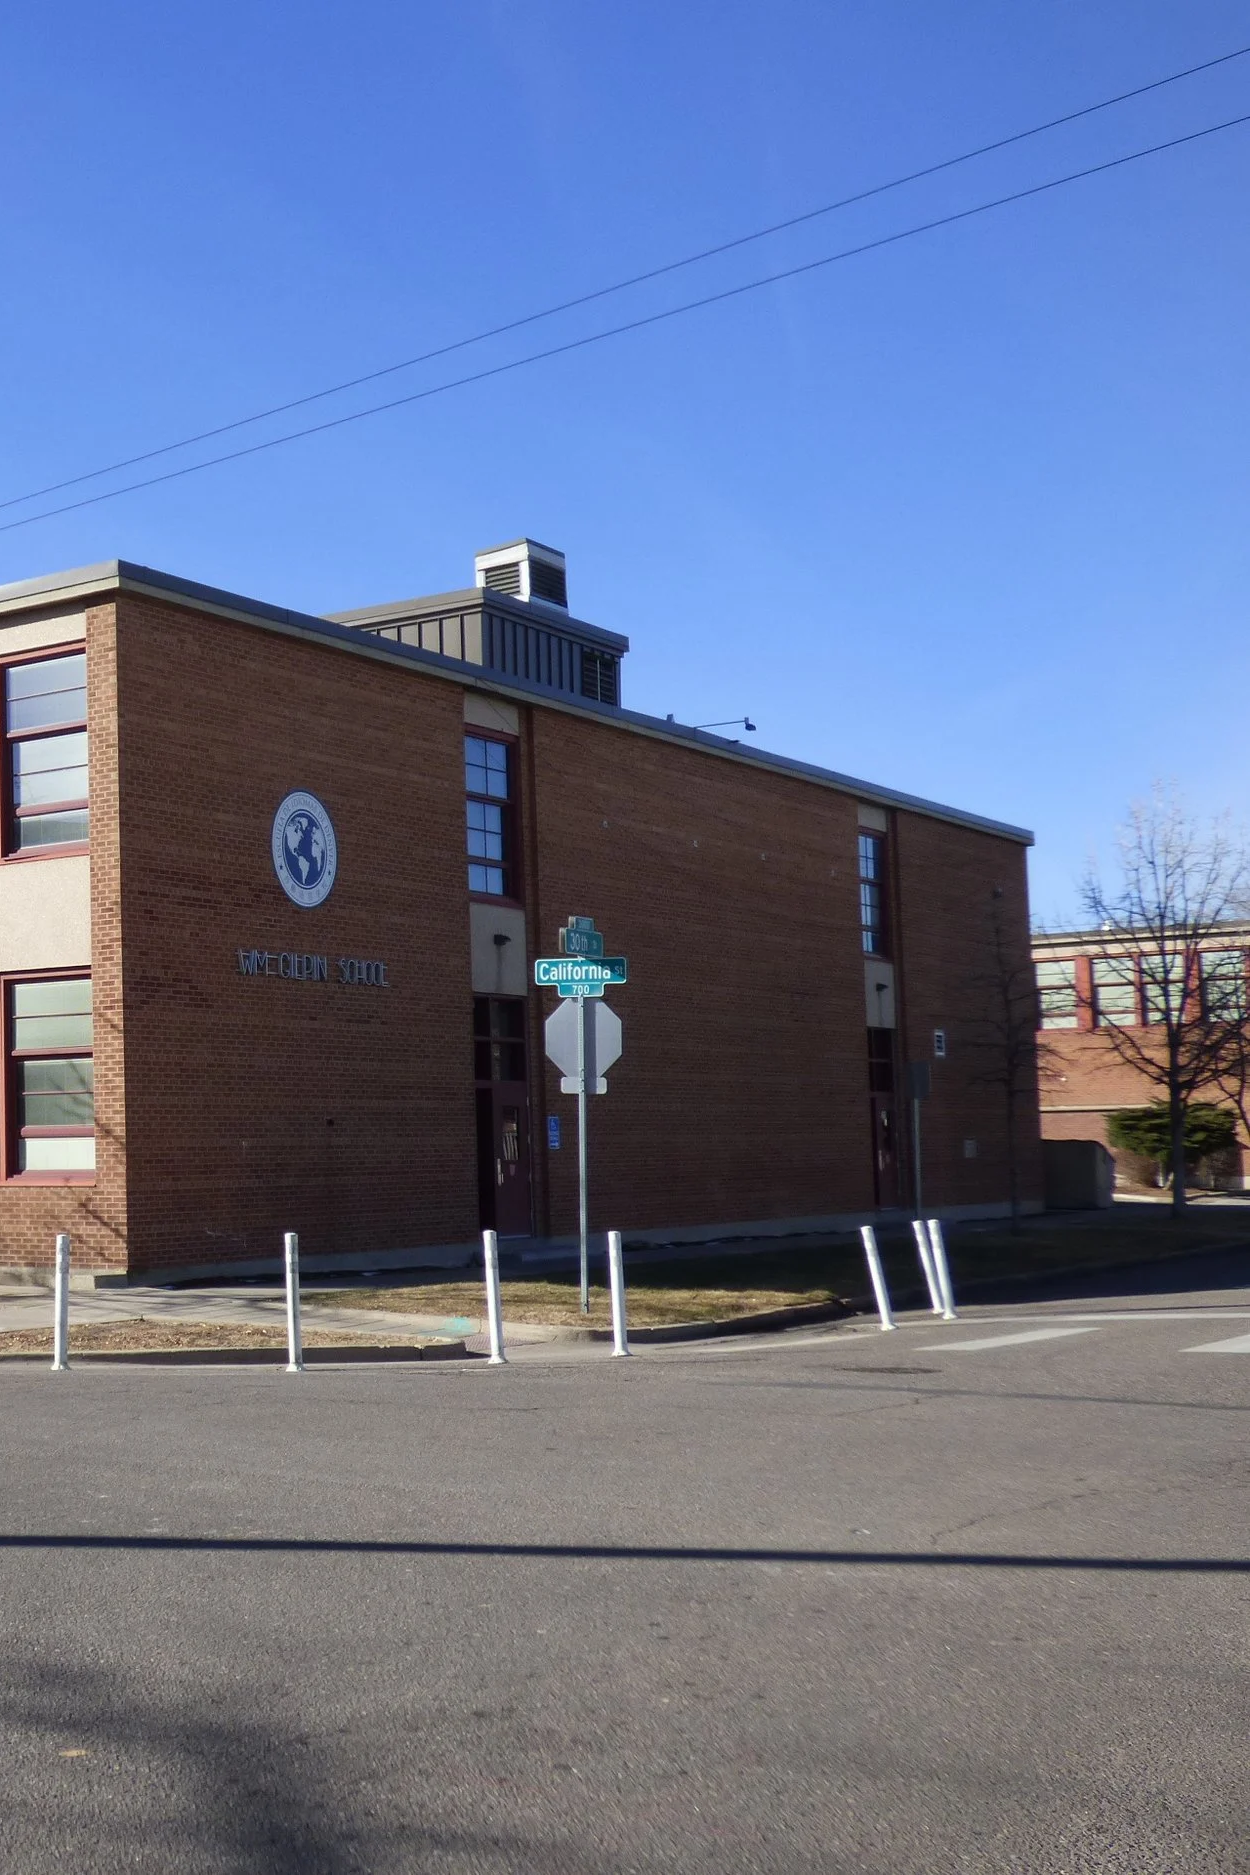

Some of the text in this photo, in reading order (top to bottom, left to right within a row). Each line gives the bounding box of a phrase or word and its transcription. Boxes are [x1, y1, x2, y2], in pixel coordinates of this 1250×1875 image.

[570, 932, 588, 952] 30th
[339, 958, 390, 987] SCHOOL
[540, 962, 623, 980] California St
[572, 985, 590, 995] 700
